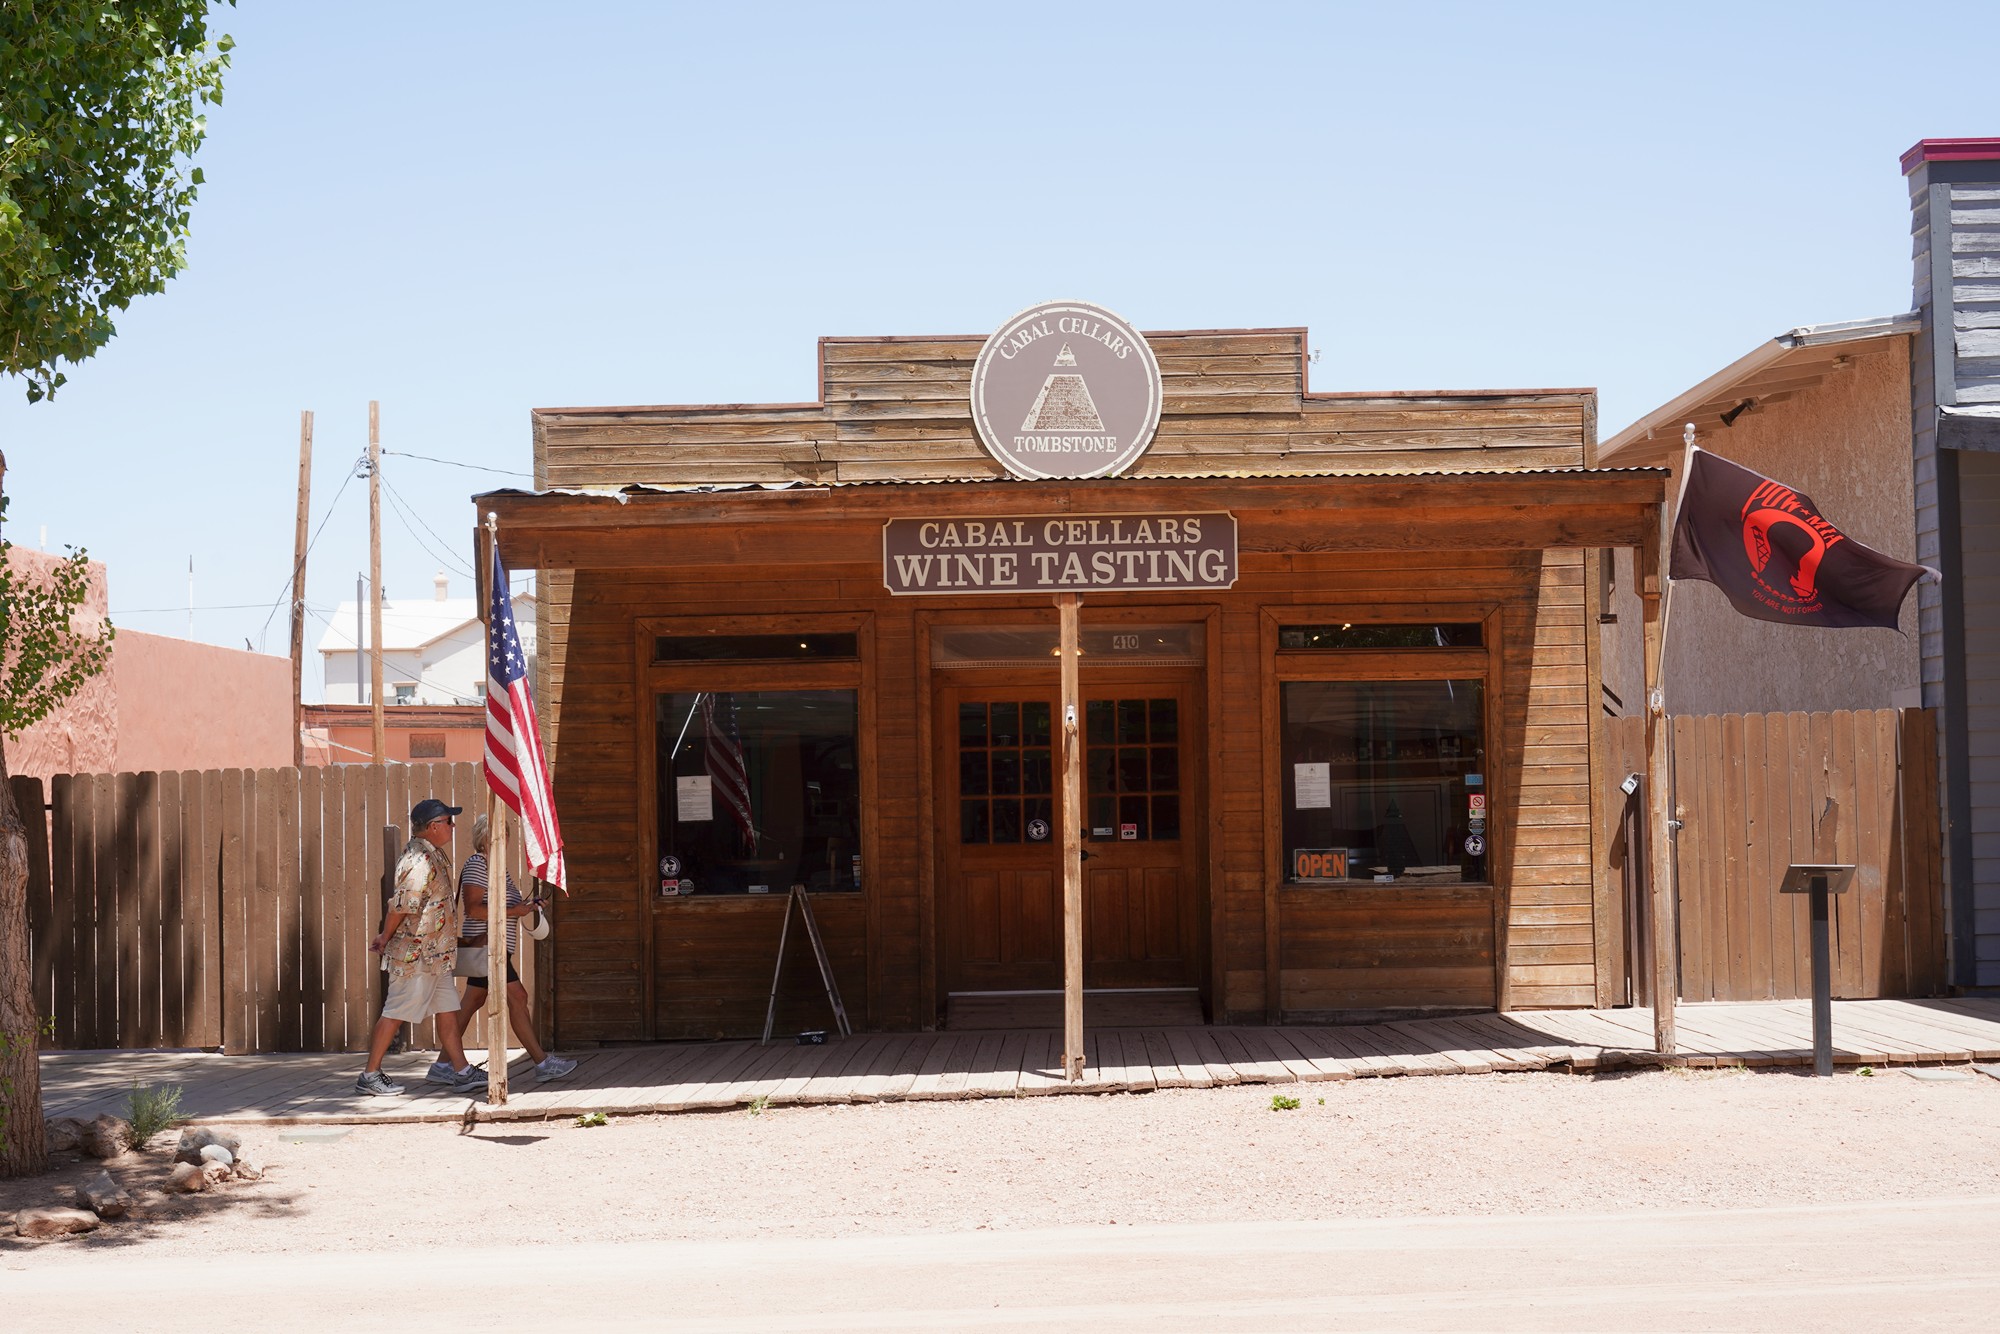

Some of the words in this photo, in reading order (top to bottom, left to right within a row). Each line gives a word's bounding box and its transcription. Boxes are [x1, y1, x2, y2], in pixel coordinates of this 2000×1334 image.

[1000, 320, 1054, 360] CABAL
[1059, 317, 1133, 360] CELLARS
[1014, 436, 1117, 453] TOMBSTONE
[1741, 480, 1802, 521] POW
[1806, 515, 1844, 550] MIA
[919, 522, 1034, 549] CABAL
[1043, 518, 1202, 547] CELLARS
[893, 553, 1018, 588] WINE
[1031, 549, 1228, 585] TASTING
[1752, 588, 1765, 602] YOU
[1765, 599, 1780, 610] ARE
[1781, 605, 1796, 615] NOT
[1114, 635, 1138, 649] 410
[1297, 853, 1345, 878] OPEN
